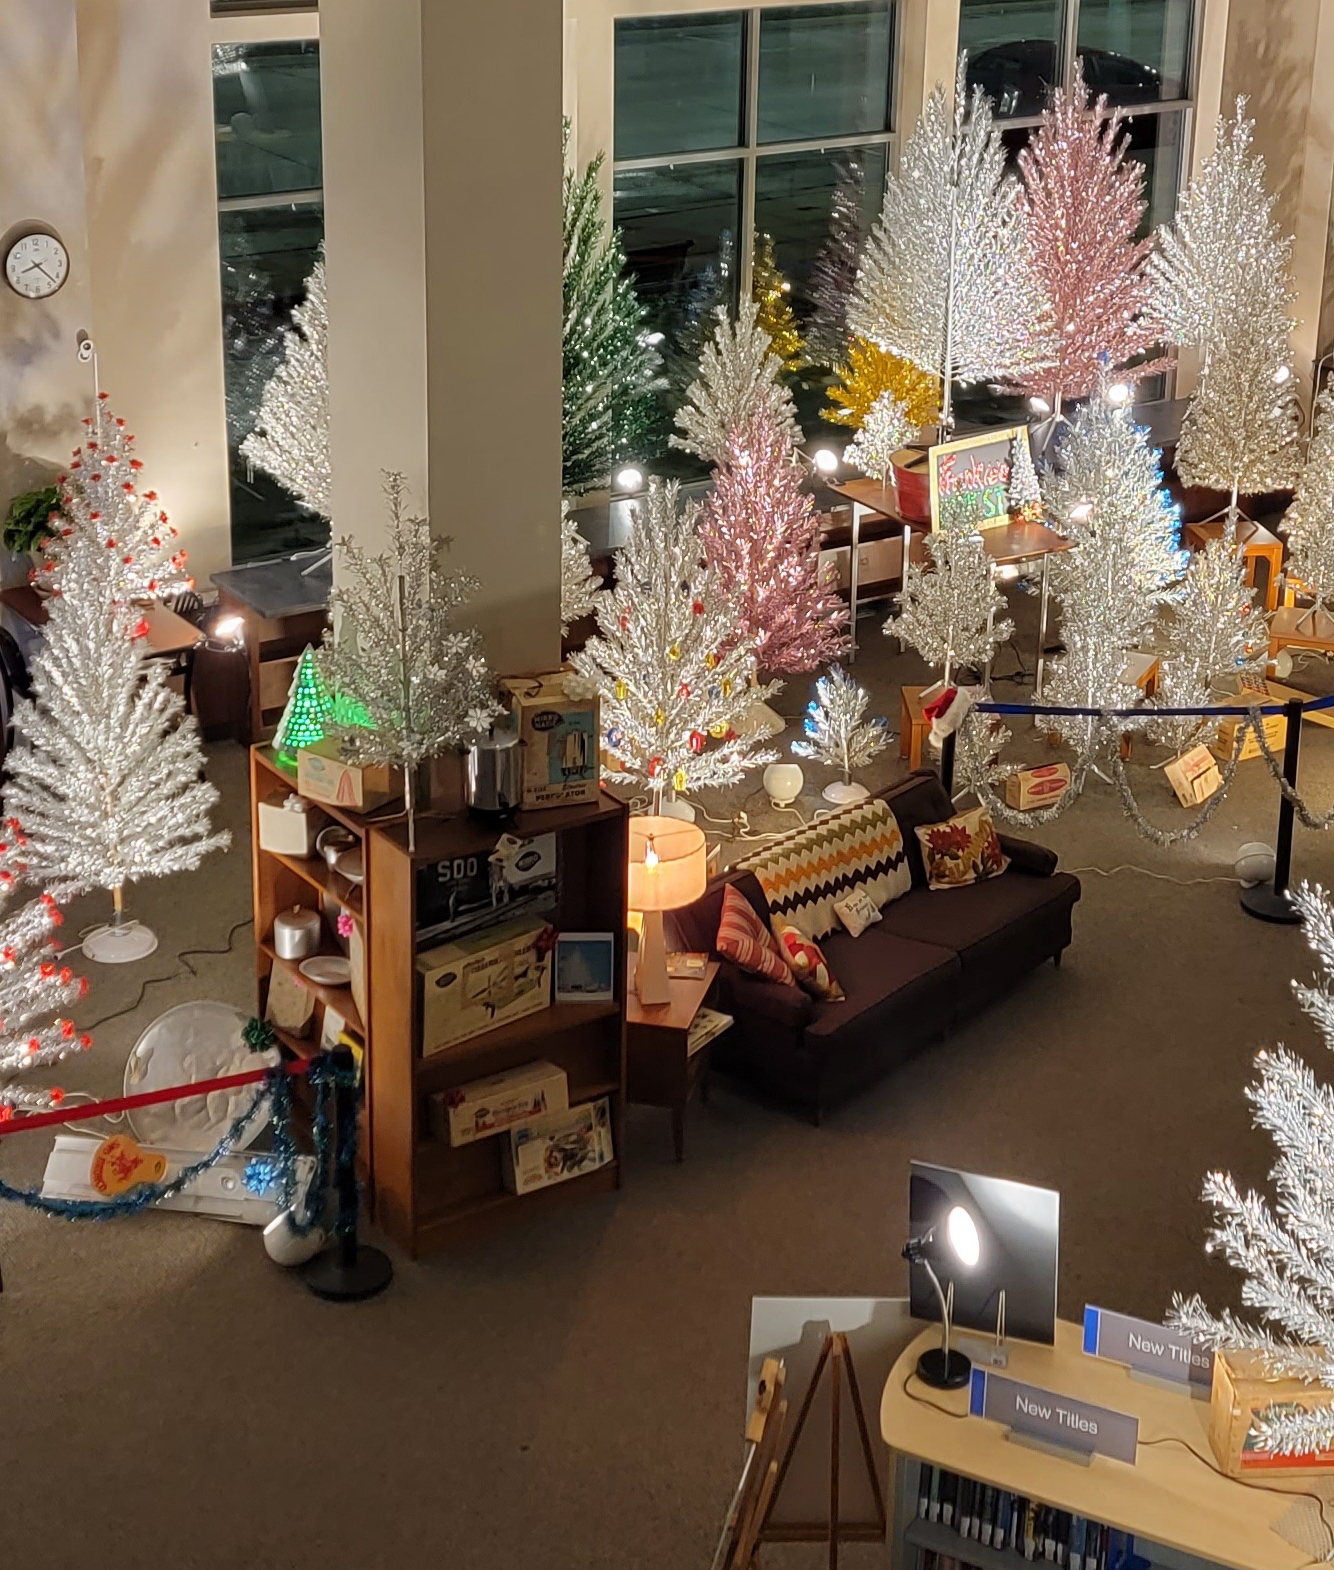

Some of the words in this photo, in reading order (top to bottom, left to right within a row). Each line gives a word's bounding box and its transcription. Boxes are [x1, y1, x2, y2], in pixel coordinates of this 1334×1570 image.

[1128, 1331, 1165, 1357] New
[1168, 1343, 1211, 1370] Titles
[1015, 1394, 1052, 1420] New
[1055, 1407, 1099, 1435] Titles
